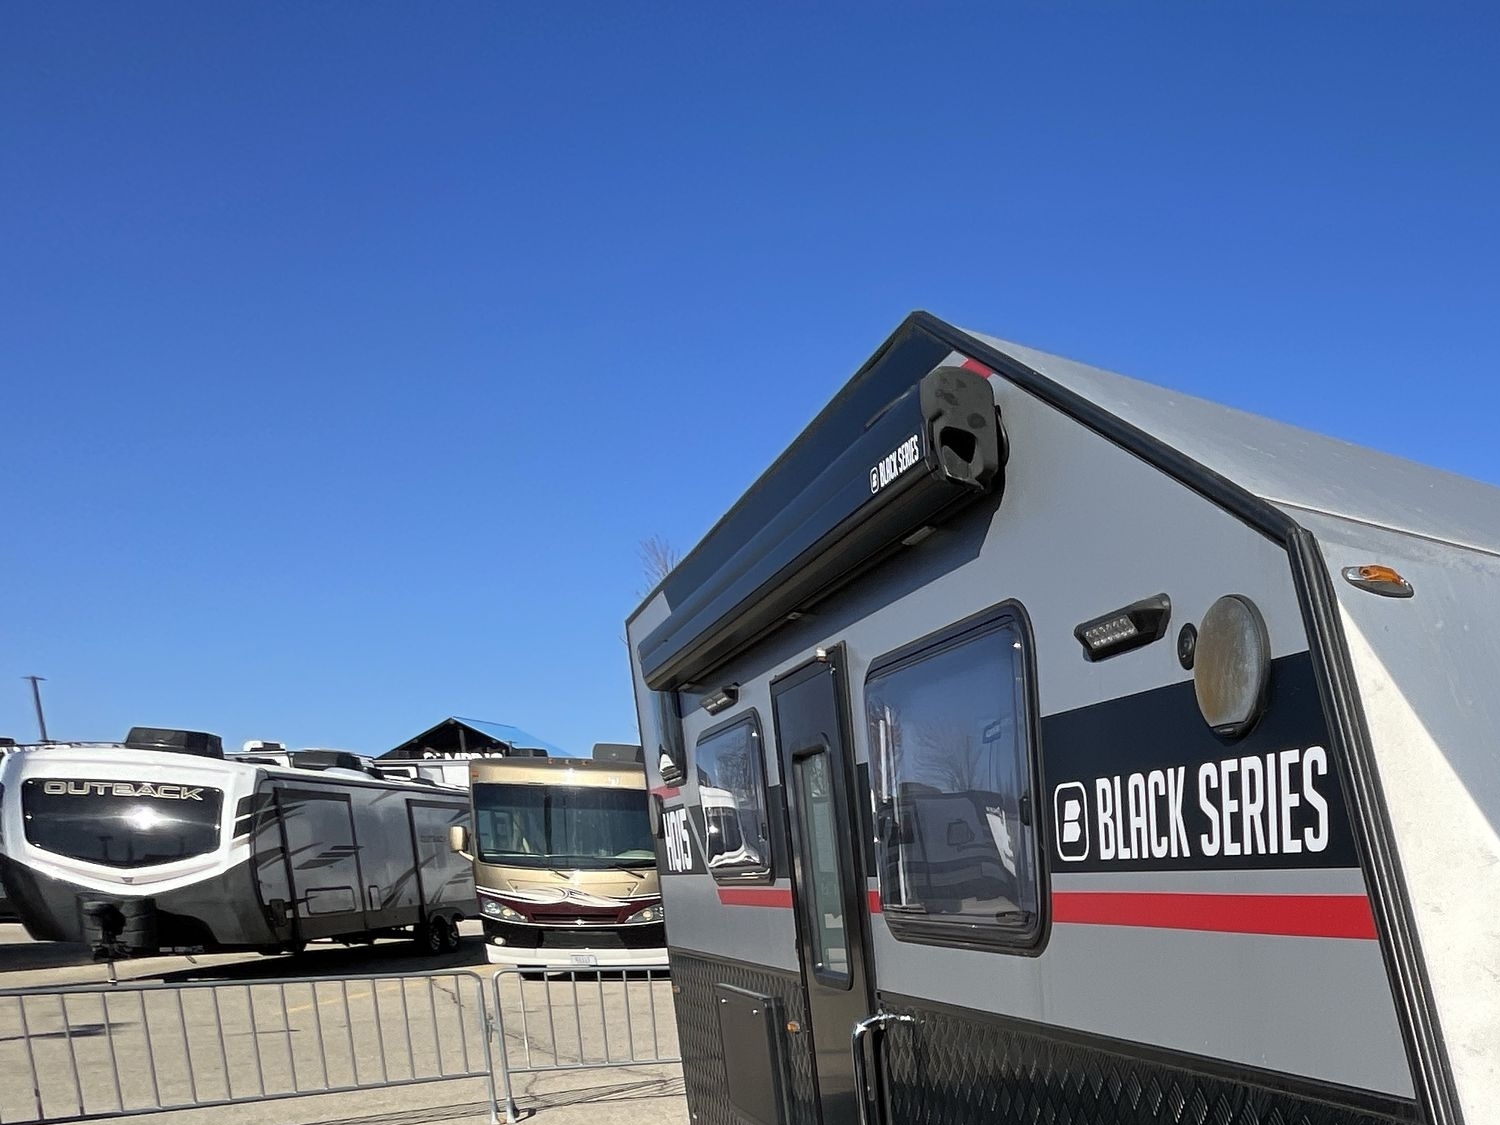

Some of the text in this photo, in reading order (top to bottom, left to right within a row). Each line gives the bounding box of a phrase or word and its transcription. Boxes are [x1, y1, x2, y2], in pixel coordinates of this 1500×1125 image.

[879, 450, 898, 487] BLACK
[898, 434, 919, 473] SERIES
[44, 781, 204, 801] OUTBACK
[1096, 766, 1190, 860] BLACK
[1198, 746, 1329, 857] SERIES
